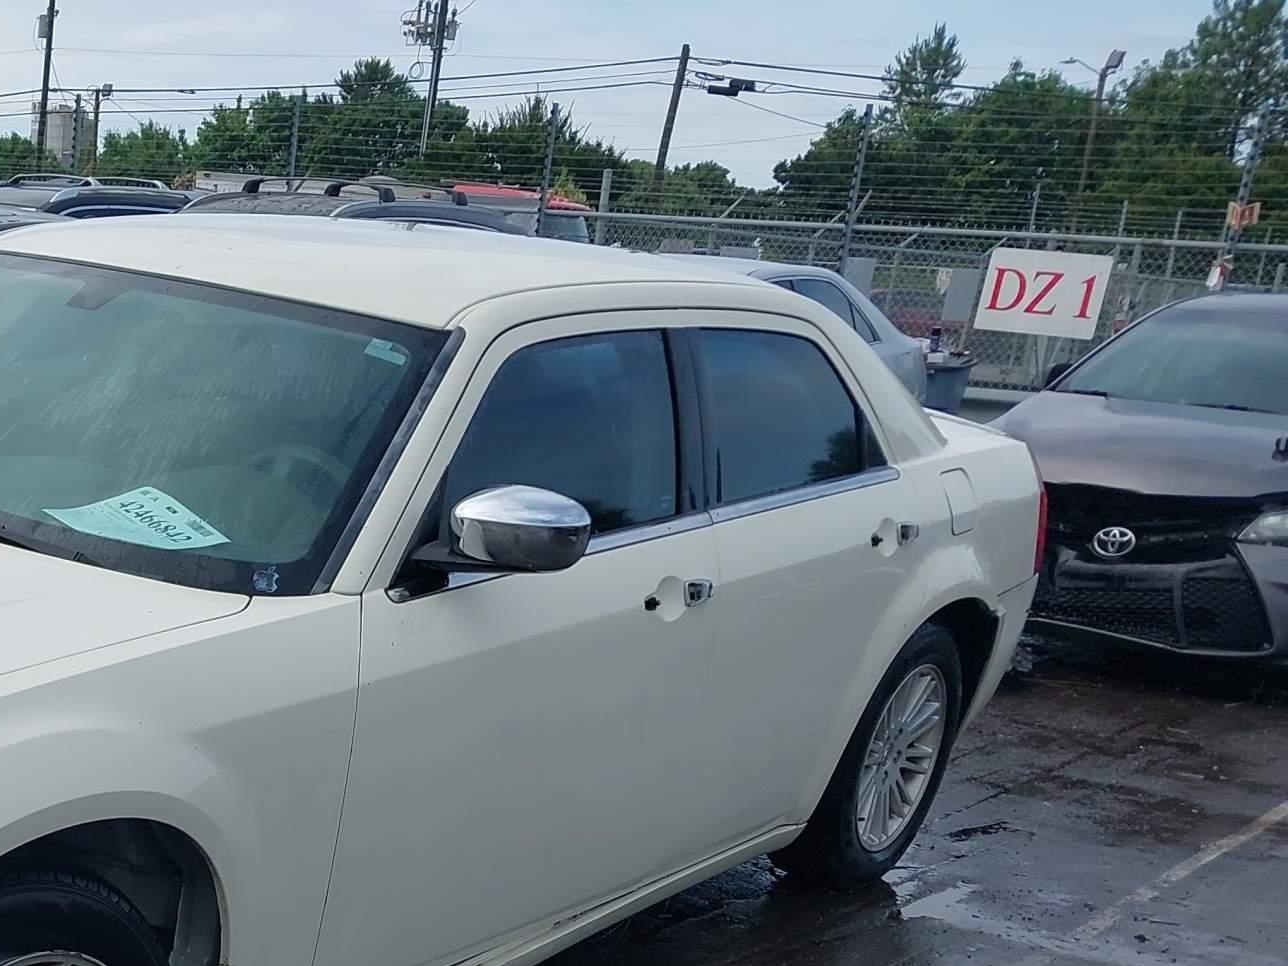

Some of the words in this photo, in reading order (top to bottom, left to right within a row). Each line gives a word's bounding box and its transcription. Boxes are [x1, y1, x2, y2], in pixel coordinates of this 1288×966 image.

[985, 267, 1065, 315] DZ
[1073, 275, 1097, 319] 1
[119, 501, 192, 543] 42466842
